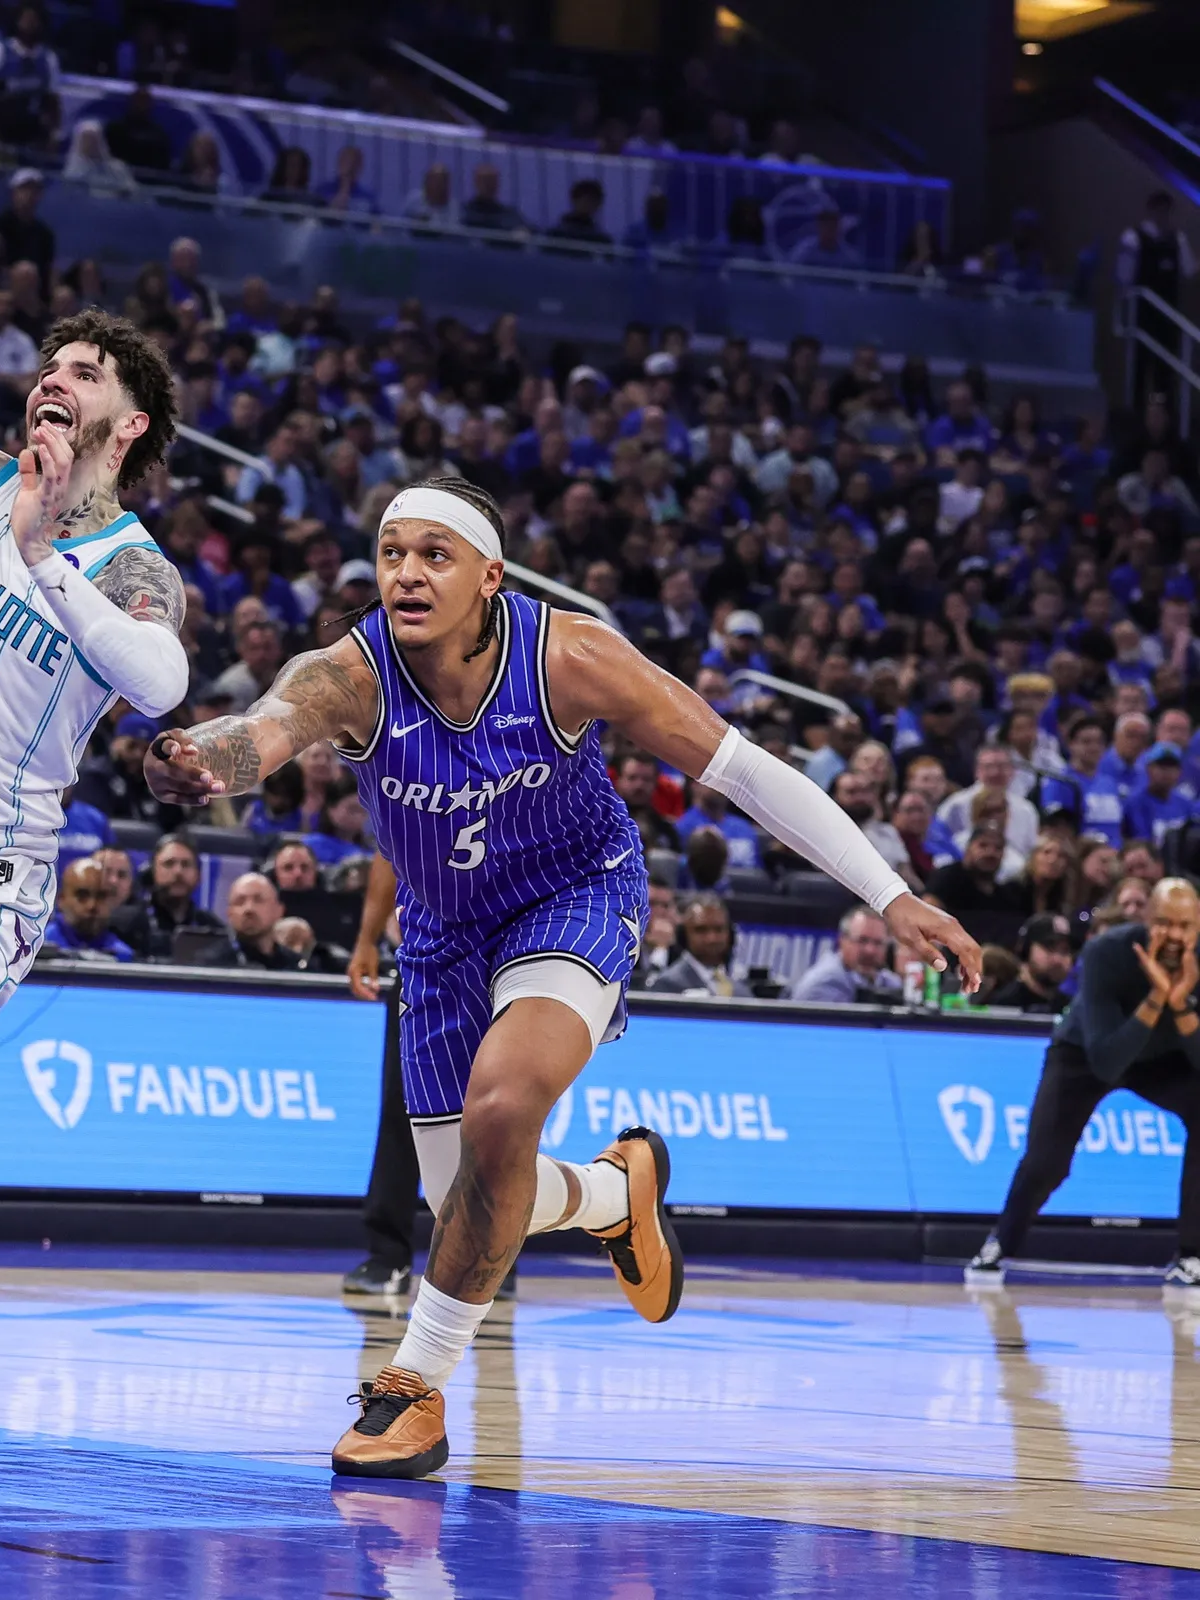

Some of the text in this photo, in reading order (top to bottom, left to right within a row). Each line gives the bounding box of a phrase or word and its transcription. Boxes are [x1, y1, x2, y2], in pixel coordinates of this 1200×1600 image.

[490, 713, 536, 729] Disney
[447, 816, 487, 871] 5
[106, 1062, 337, 1121] FANDUEL
[585, 1086, 789, 1141] FANDUEL
[1003, 1104, 1184, 1155] FDUEL
